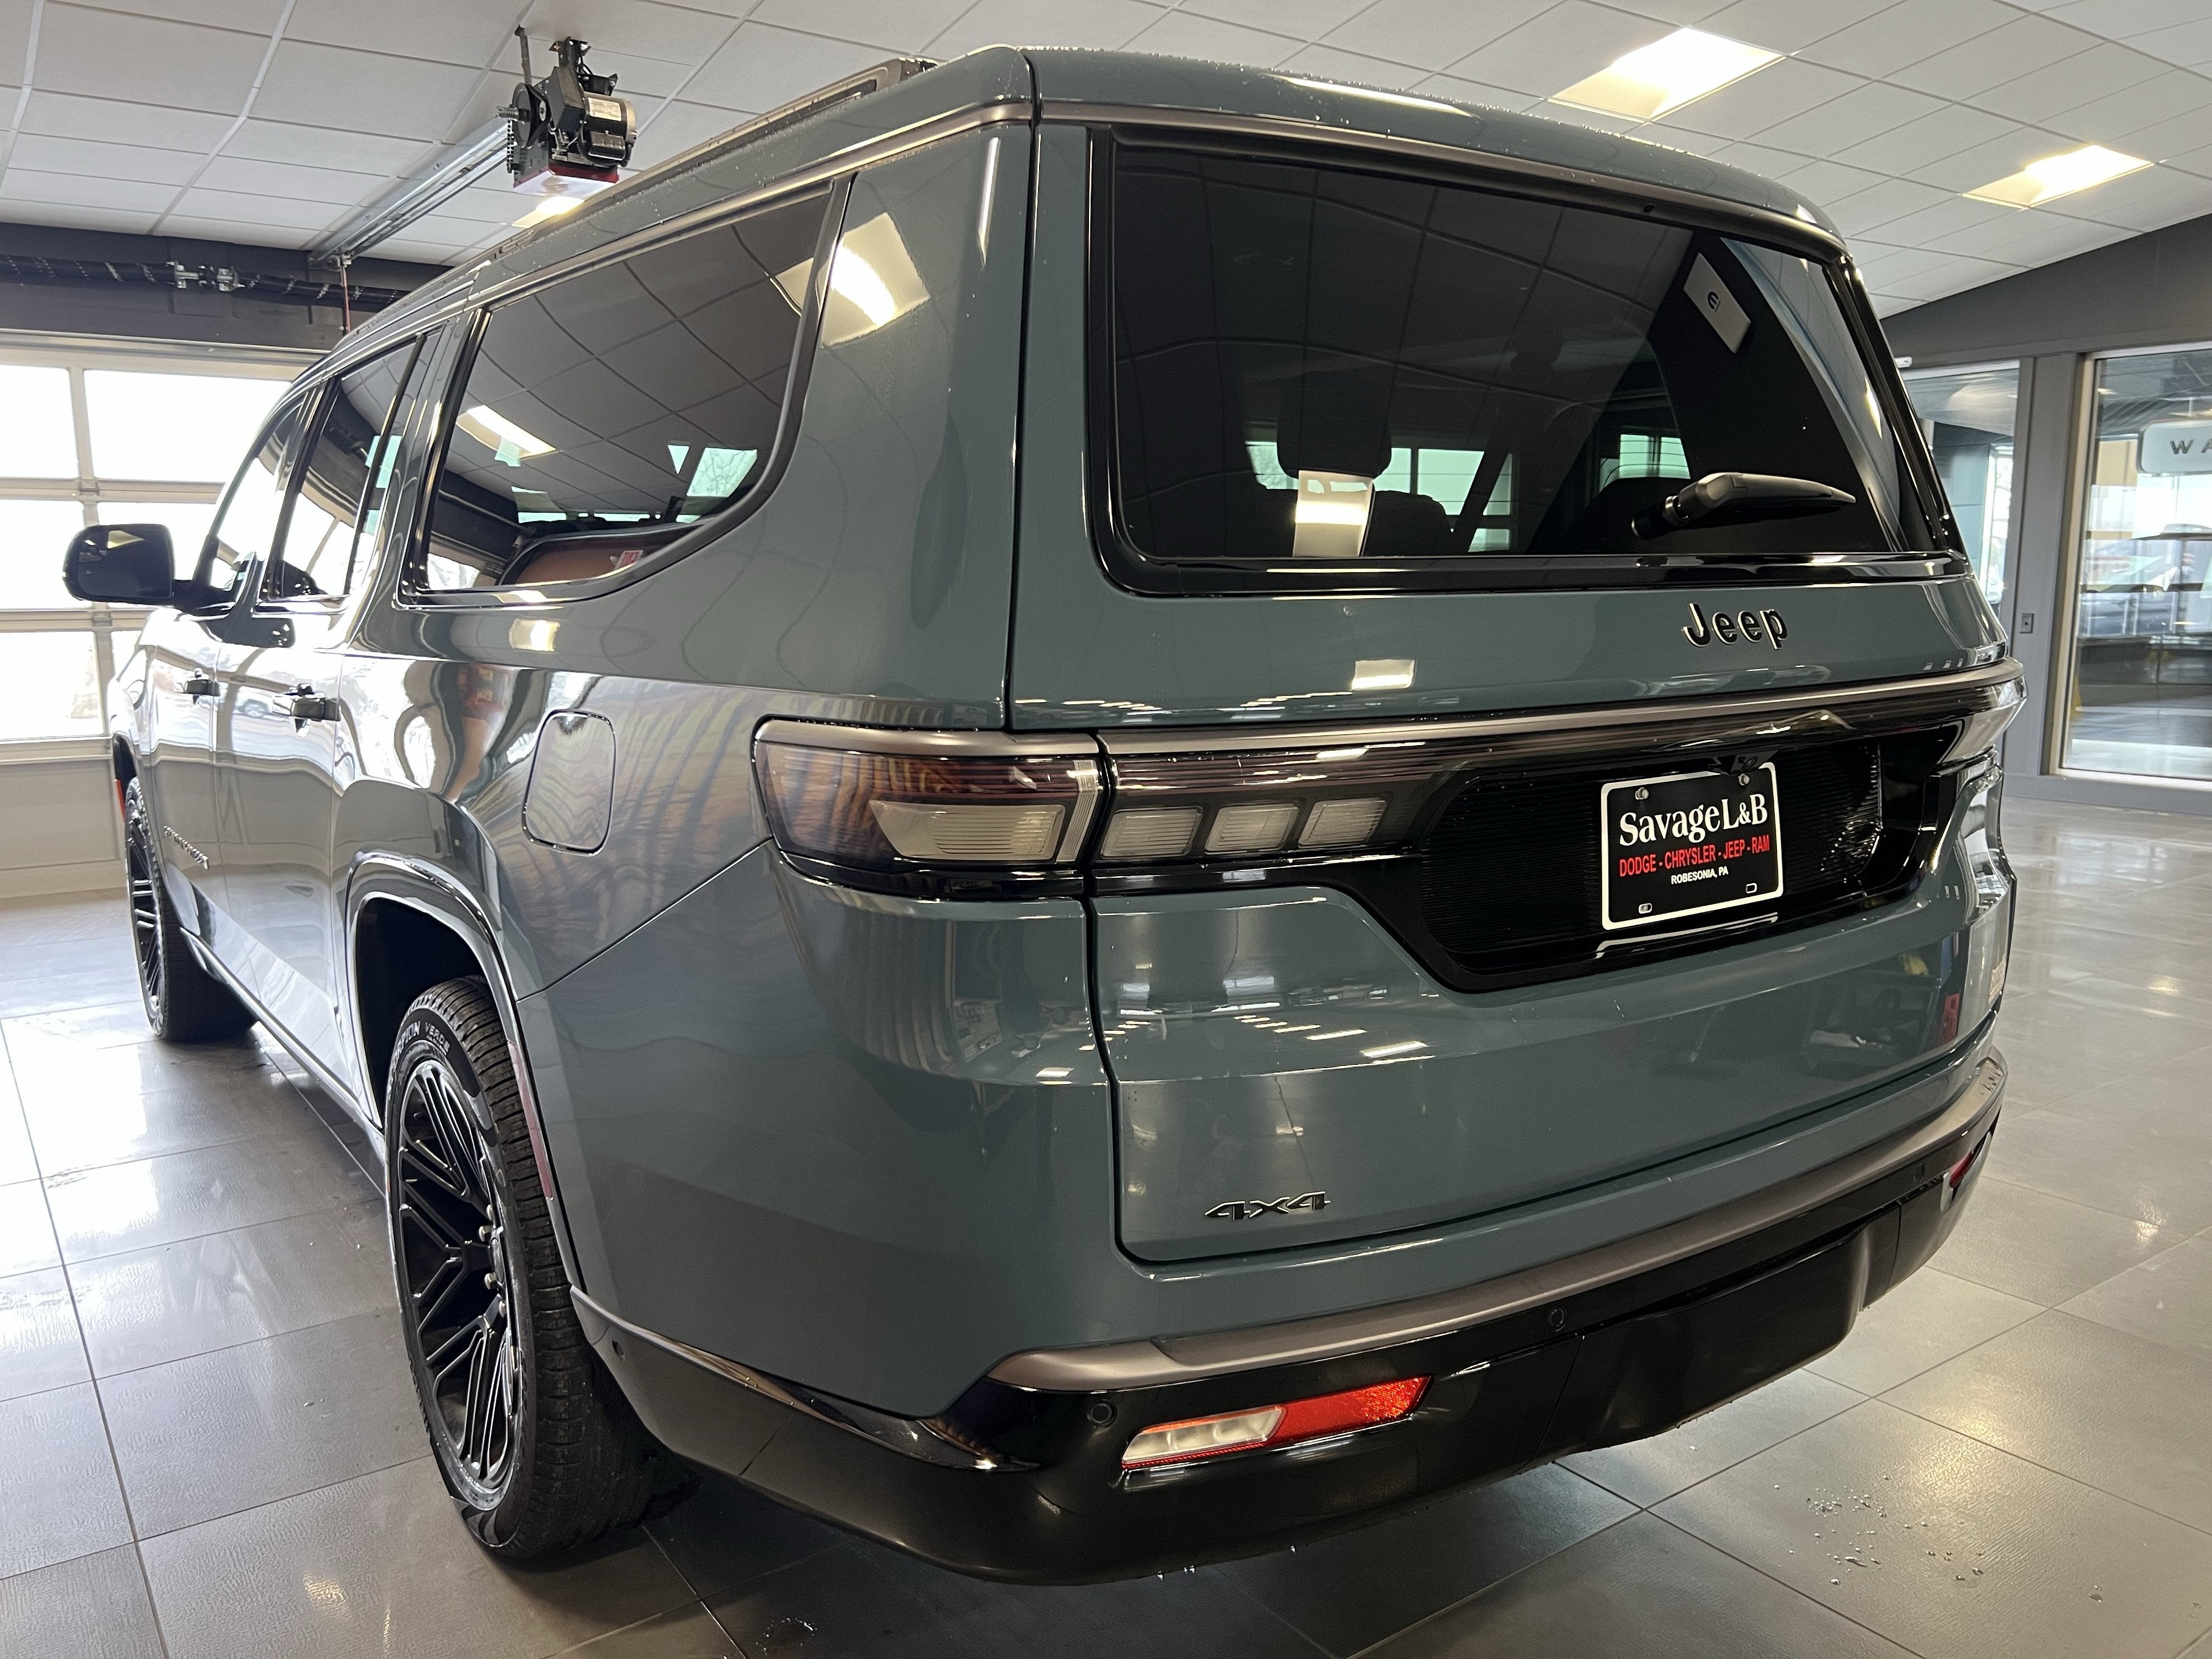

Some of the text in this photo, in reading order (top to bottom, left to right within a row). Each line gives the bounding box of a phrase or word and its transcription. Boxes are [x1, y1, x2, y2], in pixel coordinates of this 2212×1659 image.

[1681, 603, 1787, 650] Jeep
[1620, 834, 1770, 877] DODGE CHRYSLER JEEP RAM
[1671, 866, 1729, 885] ROBESONIA, PA
